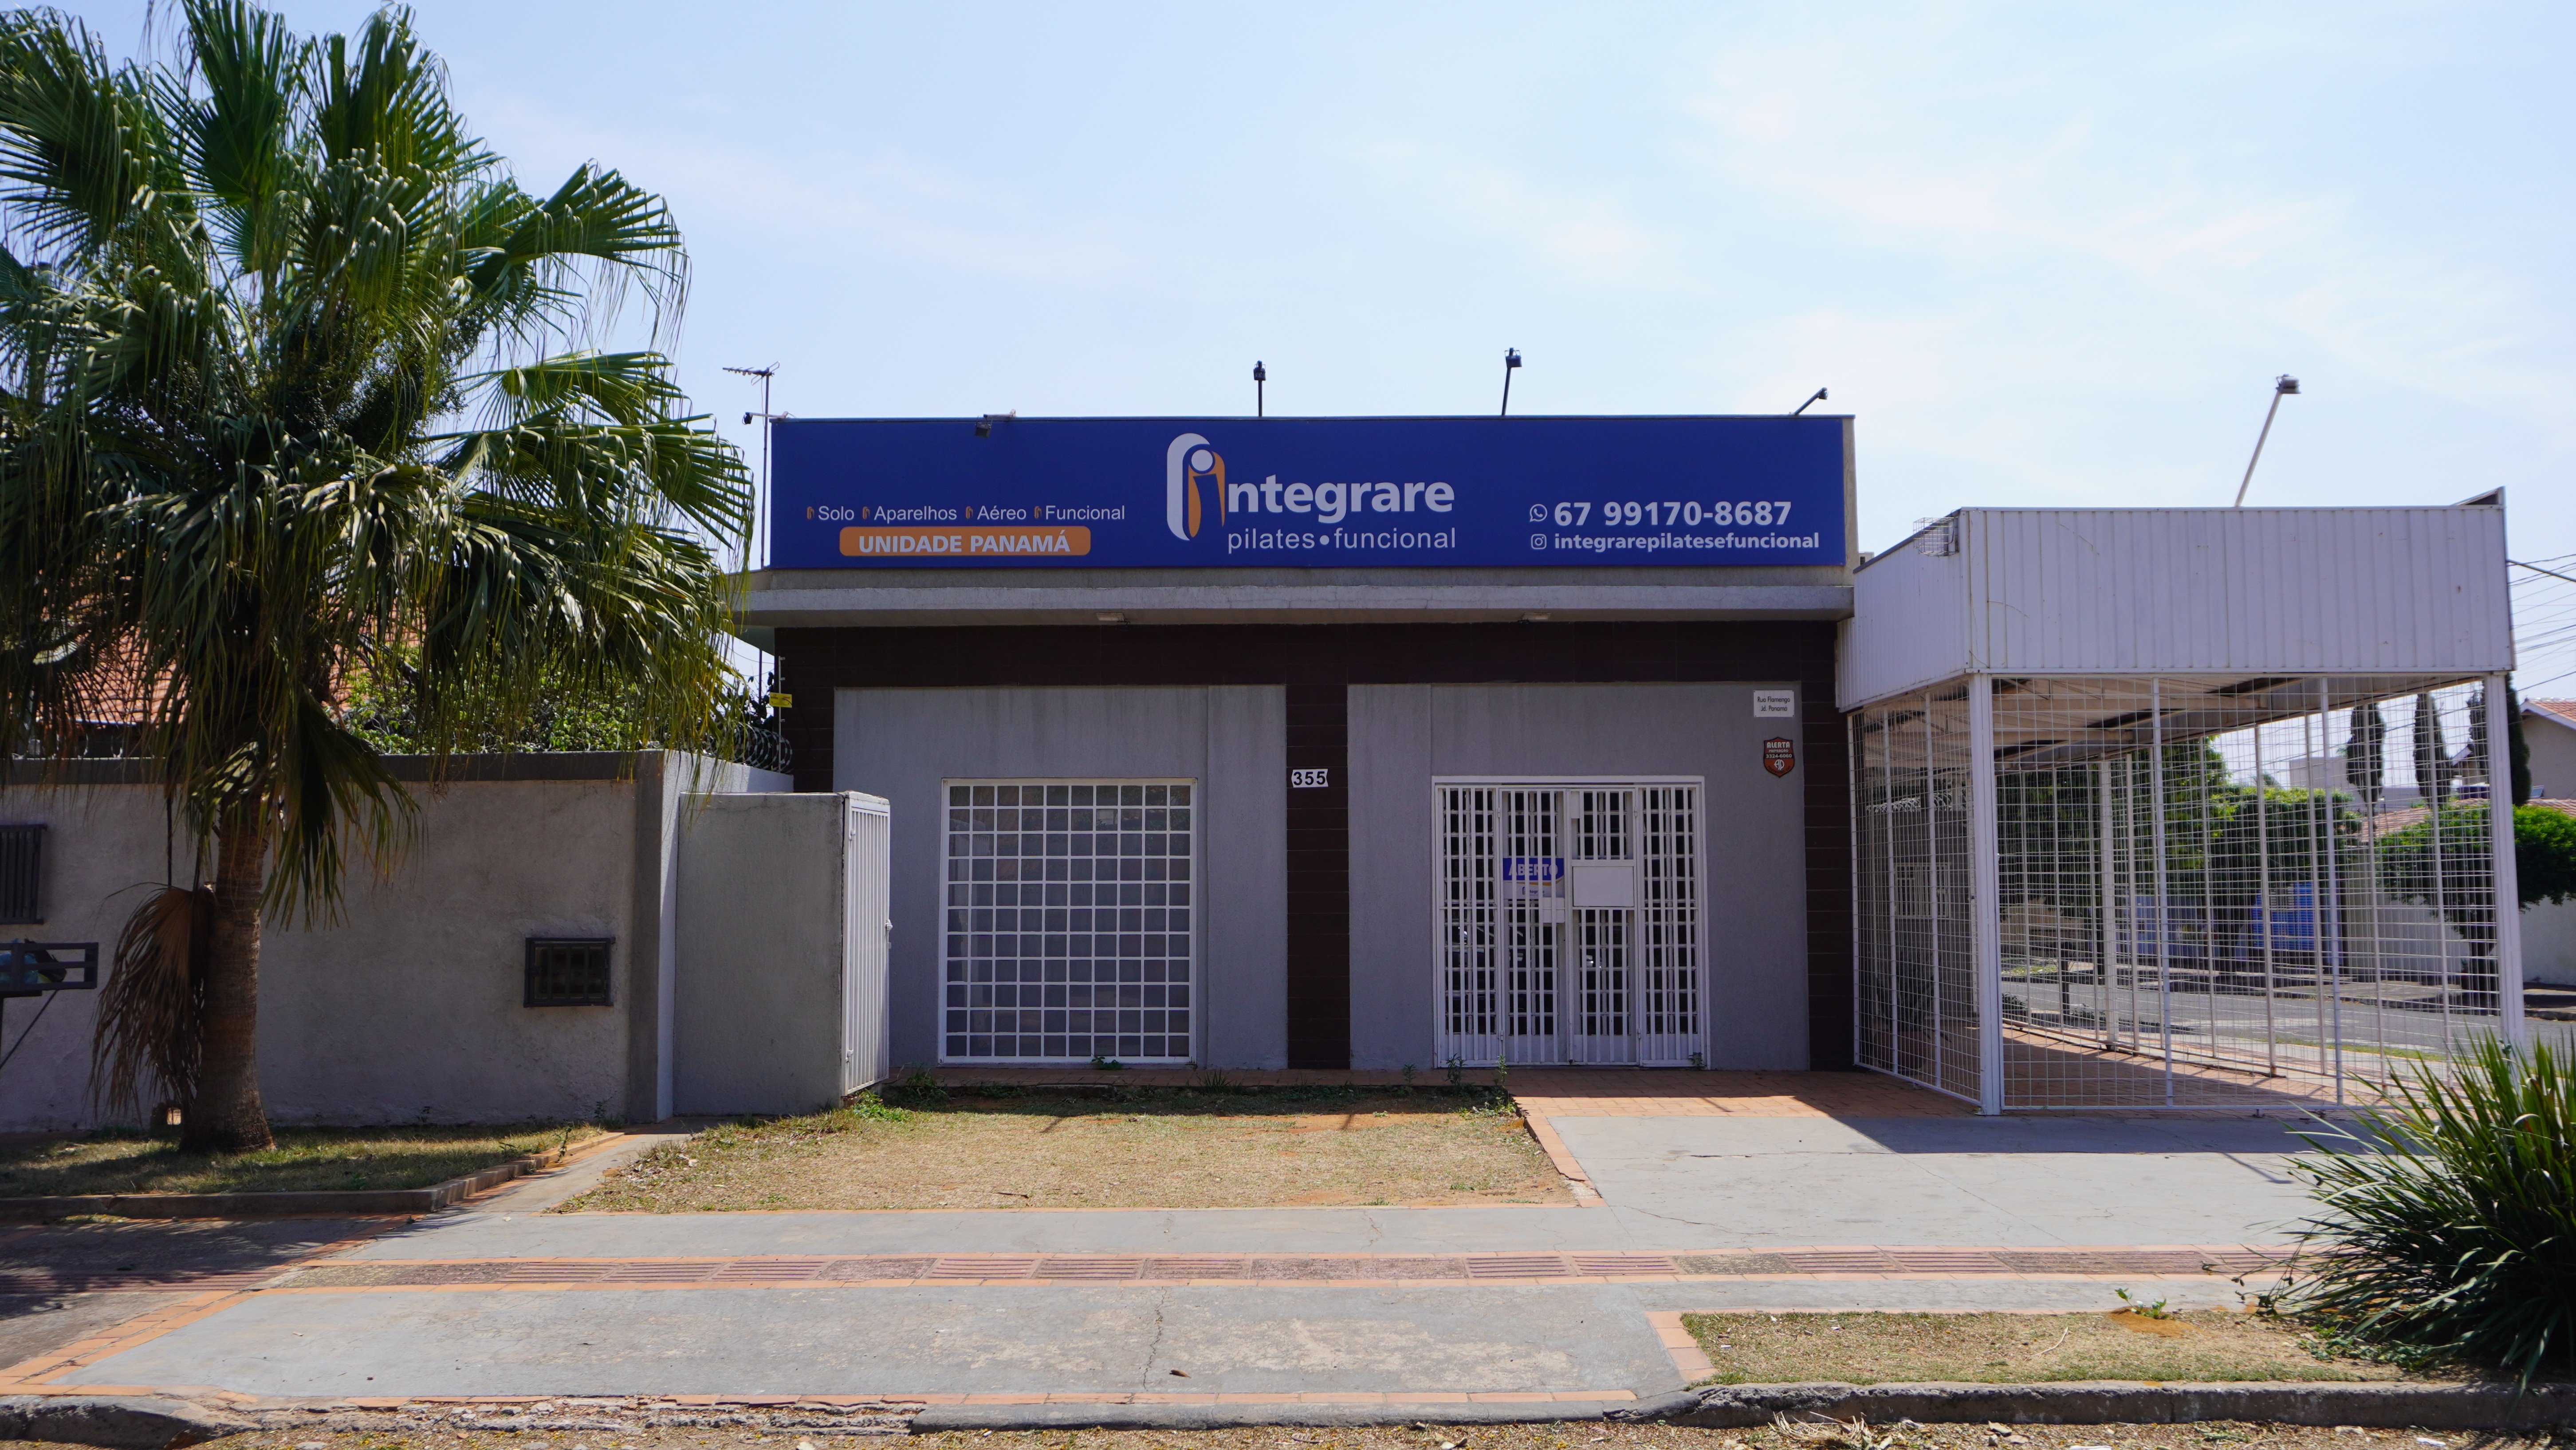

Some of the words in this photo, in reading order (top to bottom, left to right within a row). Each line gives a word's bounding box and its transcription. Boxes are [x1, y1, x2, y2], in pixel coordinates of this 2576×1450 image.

[818, 506, 855, 520] Solo
[874, 506, 957, 524] Aparelhos
[977, 506, 1027, 520] Aéreo
[1045, 505, 1125, 520] Funcional
[1554, 501, 1592, 526] 67
[1604, 501, 1792, 526] 99170-8687
[859, 535, 962, 552] UNIDADE
[970, 529, 1070, 552] PANAMÁ
[1554, 533, 1819, 552] integrarepilatesefuncional
[1293, 771, 1325, 785] 355
